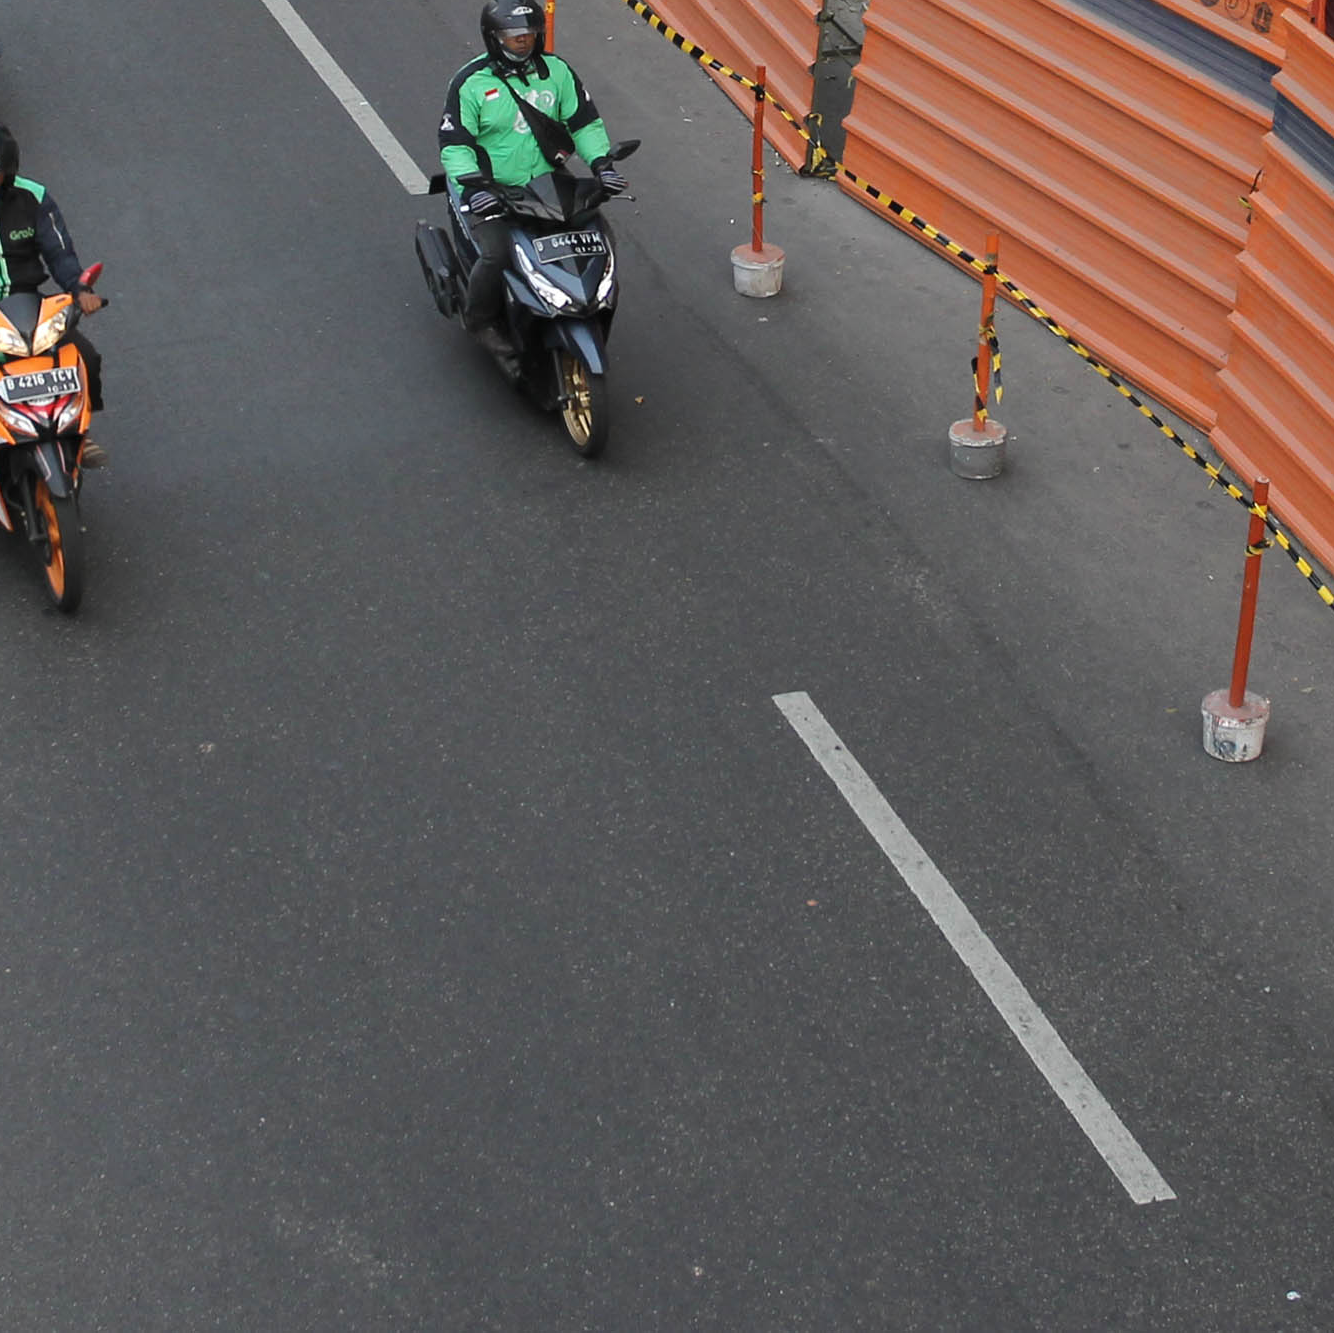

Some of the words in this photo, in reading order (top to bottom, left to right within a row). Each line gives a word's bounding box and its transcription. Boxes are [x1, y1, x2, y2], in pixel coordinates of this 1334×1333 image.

[9, 226, 36, 241] Grab
[7, 377, 16, 391] B
[18, 373, 46, 389] 4216
[51, 368, 74, 383] TCV
